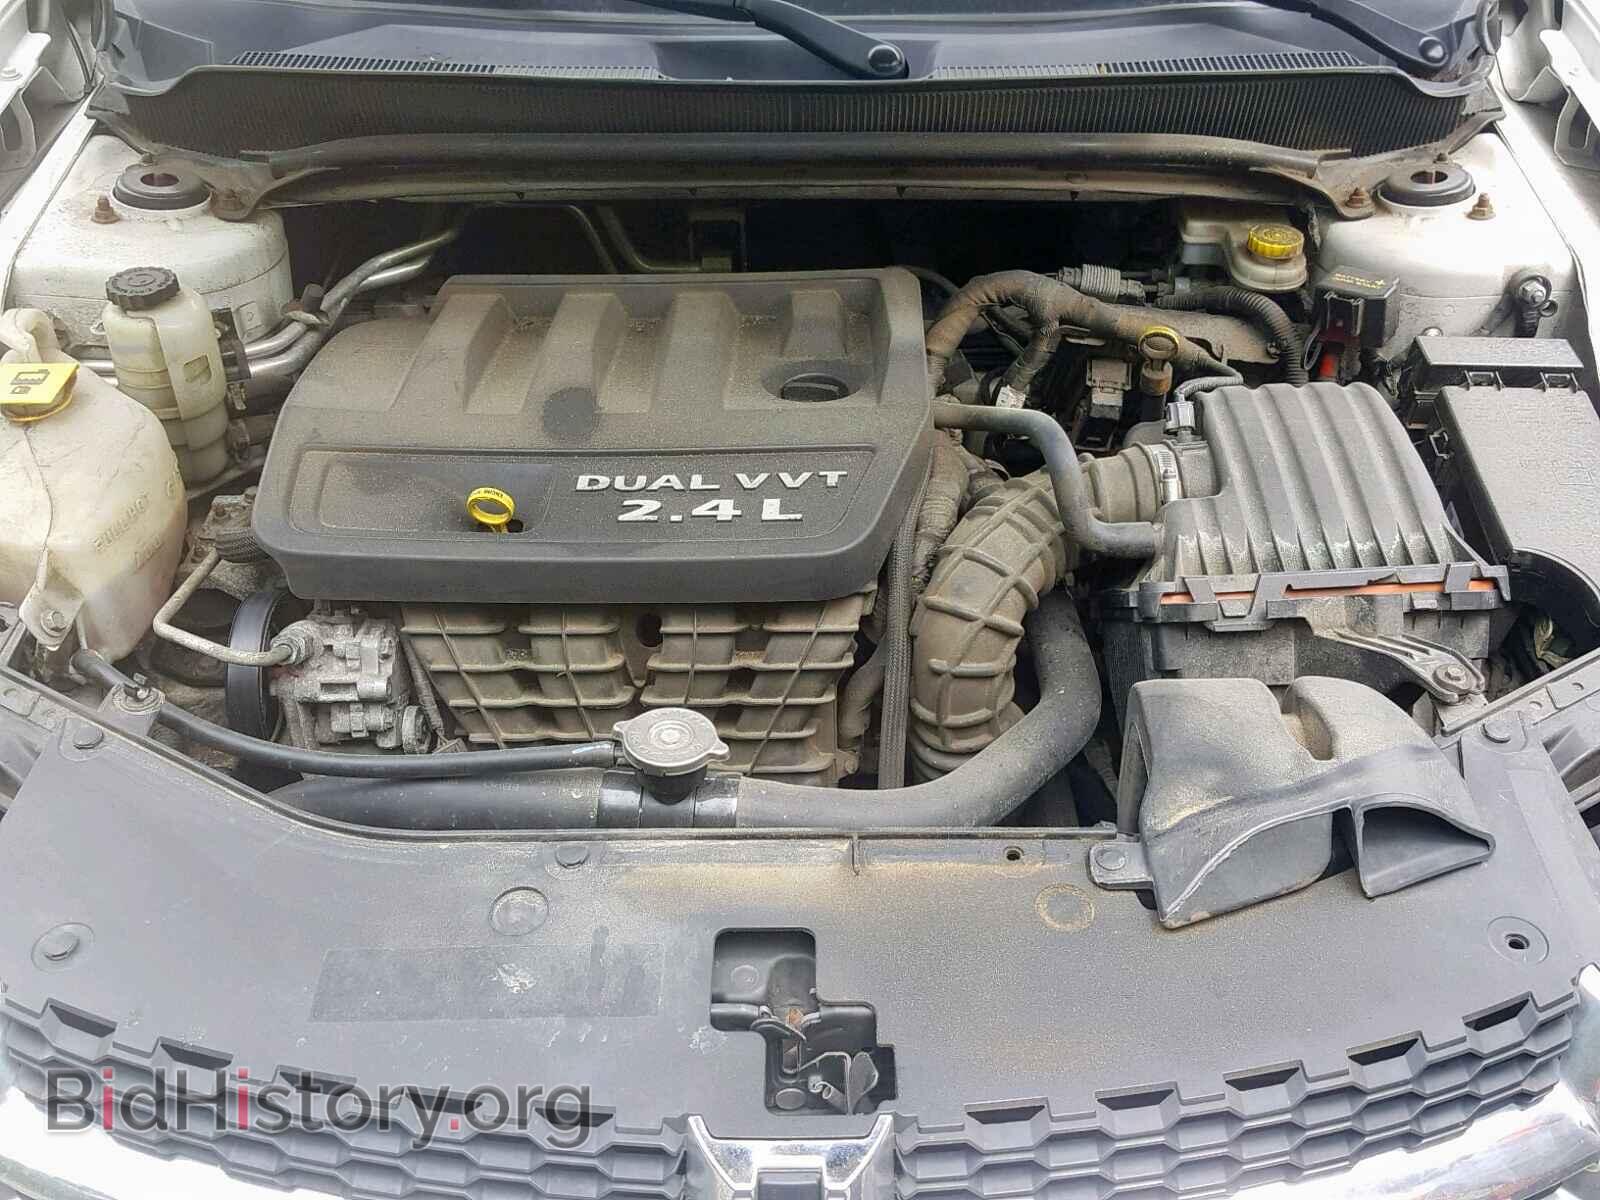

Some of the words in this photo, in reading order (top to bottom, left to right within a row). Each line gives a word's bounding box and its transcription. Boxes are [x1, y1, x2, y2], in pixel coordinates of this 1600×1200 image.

[575, 474, 721, 492] DUAL
[735, 470, 849, 489] VVT
[617, 499, 743, 522] 2.4
[761, 498, 804, 521] L
